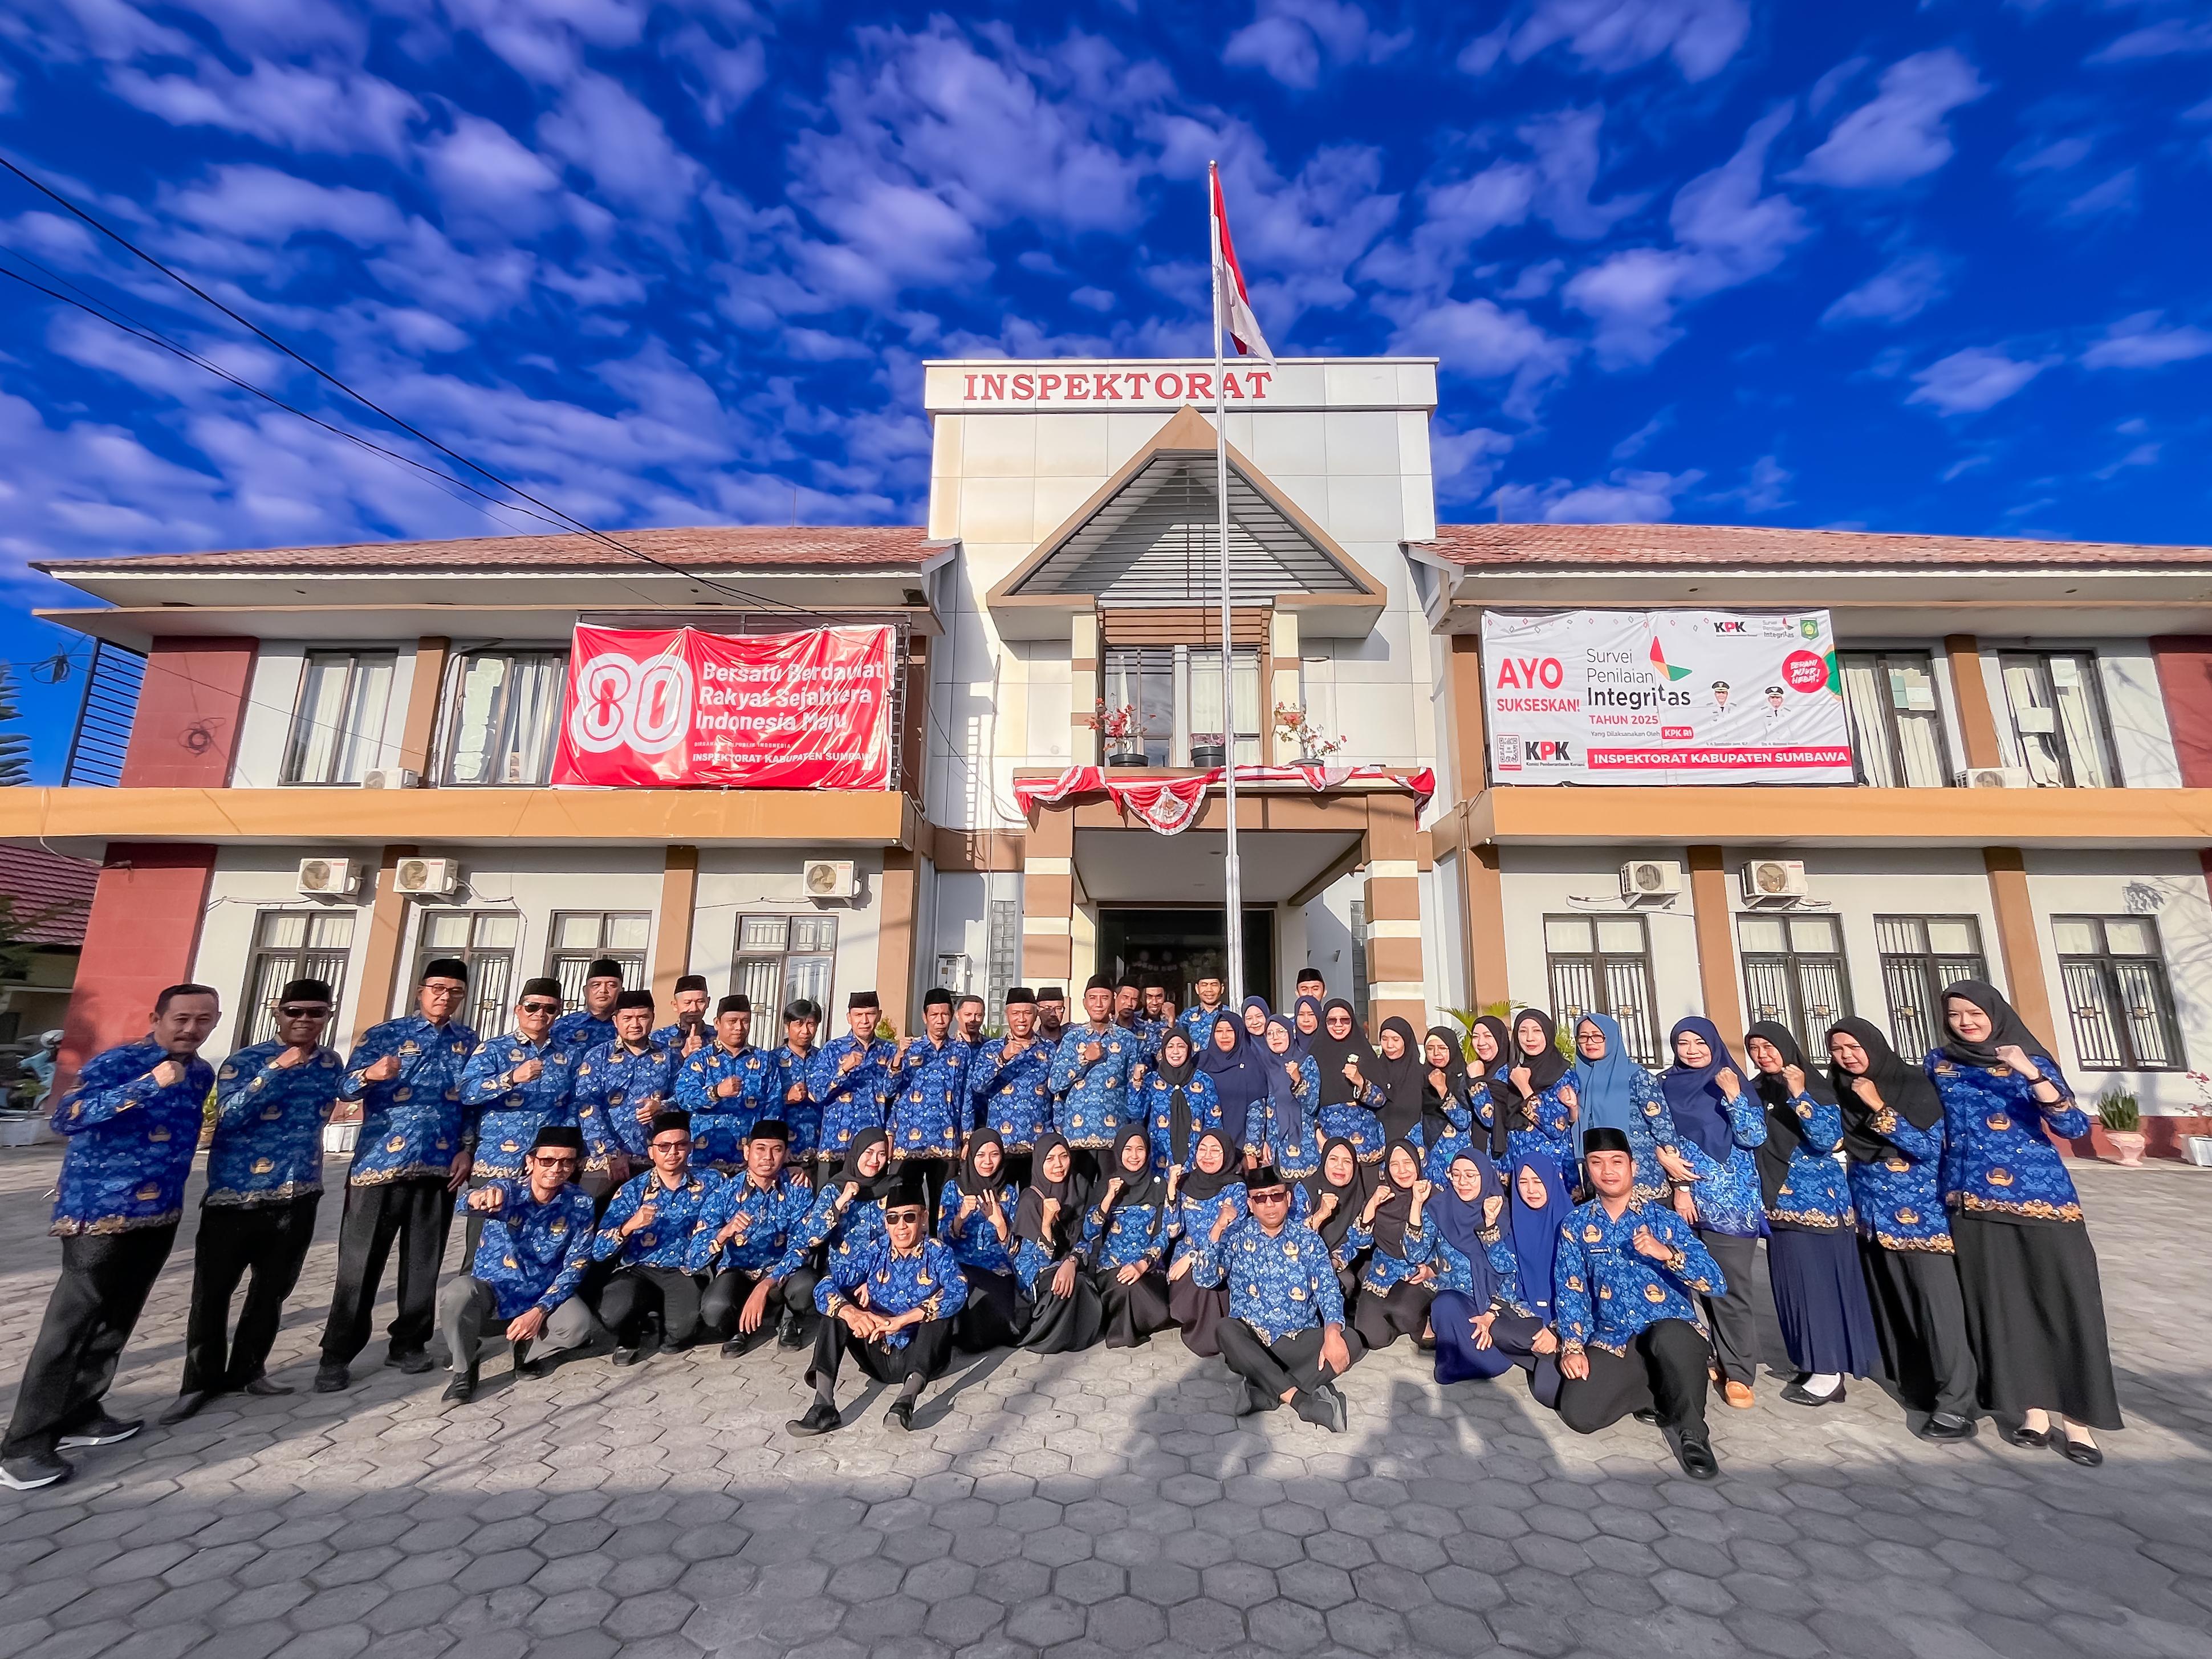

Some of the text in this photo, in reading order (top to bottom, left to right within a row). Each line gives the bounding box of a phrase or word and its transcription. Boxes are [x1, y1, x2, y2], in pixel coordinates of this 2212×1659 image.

[963, 372, 1272, 400] INSPEKTORAT
[1714, 621, 1747, 632] KPK
[1587, 649, 1632, 663] Survei
[703, 661, 884, 682] Bersatu Berdaulat
[1497, 657, 1563, 689] AYO
[1587, 668, 1654, 684] Penilaian
[571, 653, 693, 754] 80
[700, 686, 872, 710] Rakyat Sejahtera
[1497, 698, 1580, 712] SUKSESKAN!
[1588, 684, 1691, 710] Integritas
[696, 710, 846, 733] Indonesia Maju
[1589, 715, 1658, 725] TAHUN 2025
[692, 753, 762, 763] INSPEKTORAT
[765, 752, 823, 763] KABUPATEN
[1525, 742, 1571, 761] KPK
[1595, 752, 1847, 764] INSPEKTORAT KABUPATEN SUMBAWA
